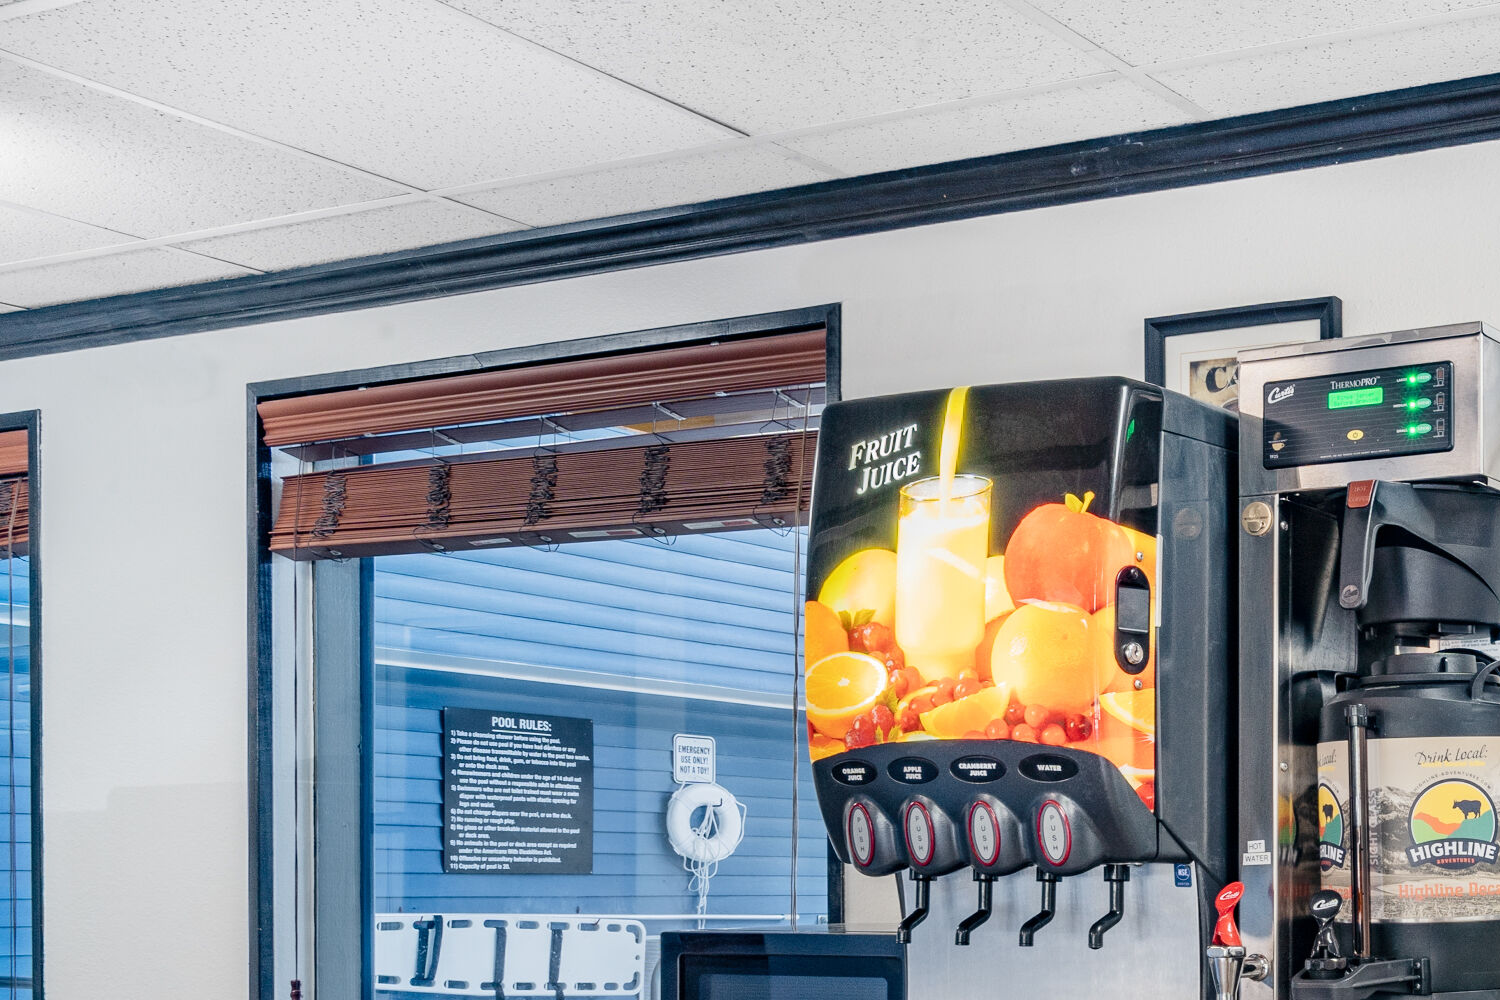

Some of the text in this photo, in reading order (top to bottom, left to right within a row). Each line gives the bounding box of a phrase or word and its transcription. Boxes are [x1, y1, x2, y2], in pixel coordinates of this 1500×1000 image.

[848, 423, 918, 471] FRUIT
[857, 450, 921, 495] JUICE
[491, 716, 552, 732] POOL RULES:
[678, 745, 710, 755] EMERGENCY
[1415, 749, 1452, 766] Drink
[681, 755, 691, 763] USE
[680, 766, 691, 774] NOT
[1036, 764, 1062, 772] WATER
[980, 815, 989, 850] PUSH
[1050, 815, 1059, 850] PUSH
[1244, 854, 1270, 862] WATER
[1409, 841, 1496, 863] HIGHLINE
[1436, 857, 1475, 865] ADVENTURES
[1398, 883, 1464, 901] Highline
